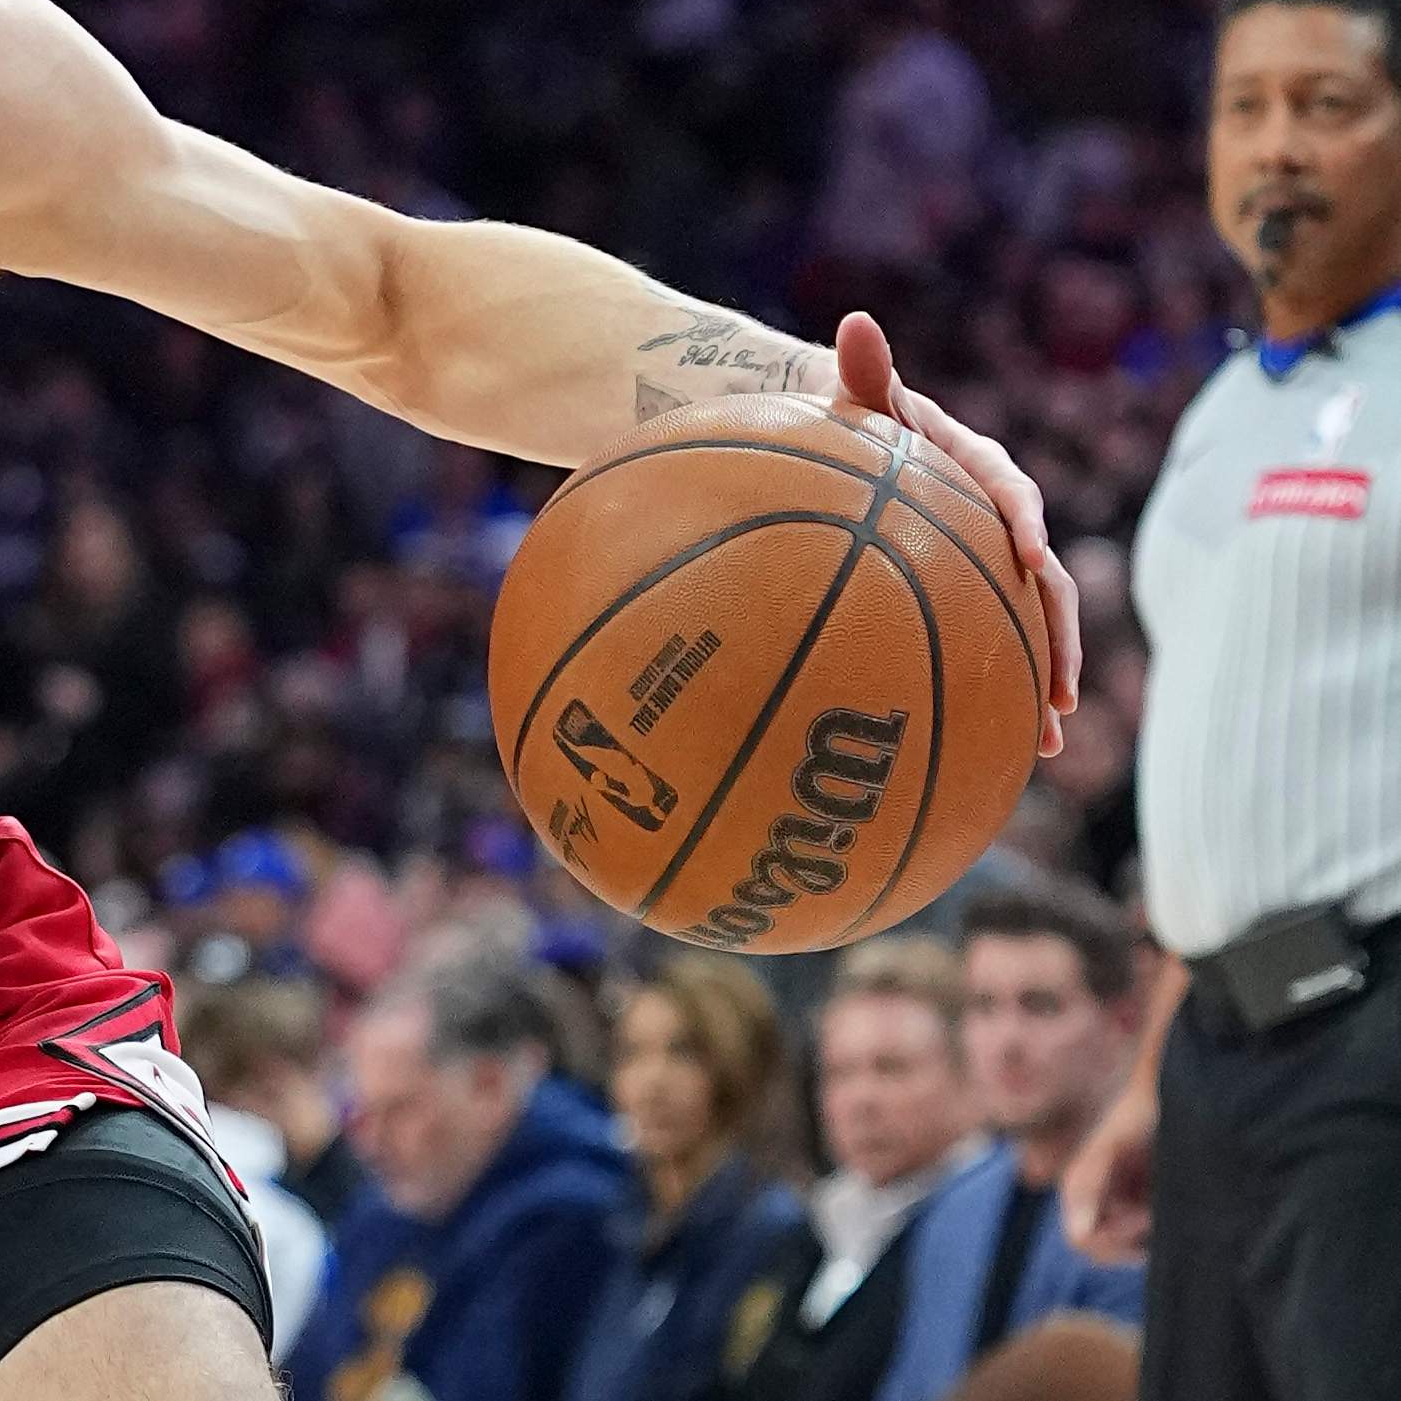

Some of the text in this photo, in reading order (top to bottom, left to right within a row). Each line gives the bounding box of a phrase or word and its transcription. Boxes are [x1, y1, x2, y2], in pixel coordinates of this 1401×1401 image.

[628, 629, 722, 737] OFFICIAL GAME BALL
